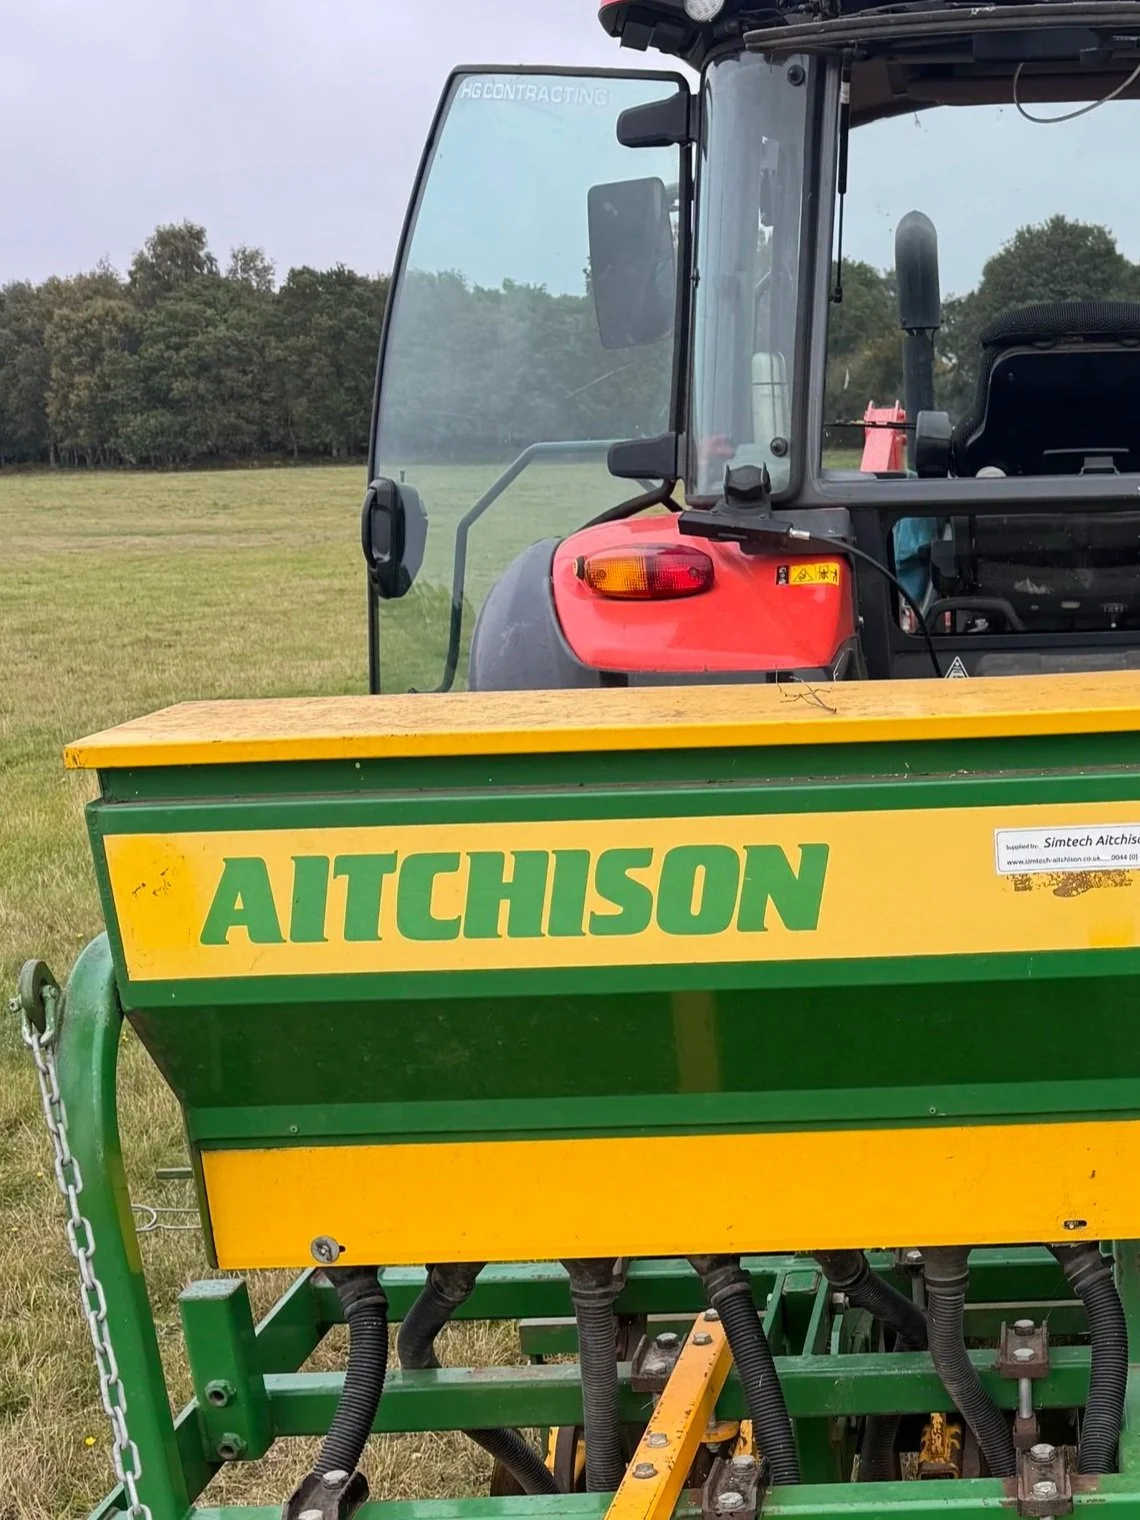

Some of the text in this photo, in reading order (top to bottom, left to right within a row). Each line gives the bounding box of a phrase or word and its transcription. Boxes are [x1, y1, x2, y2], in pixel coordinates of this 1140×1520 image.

[483, 83, 608, 106] CONTRACTING
[1043, 834, 1093, 848] Simtech
[200, 842, 830, 945] AITCHISON
